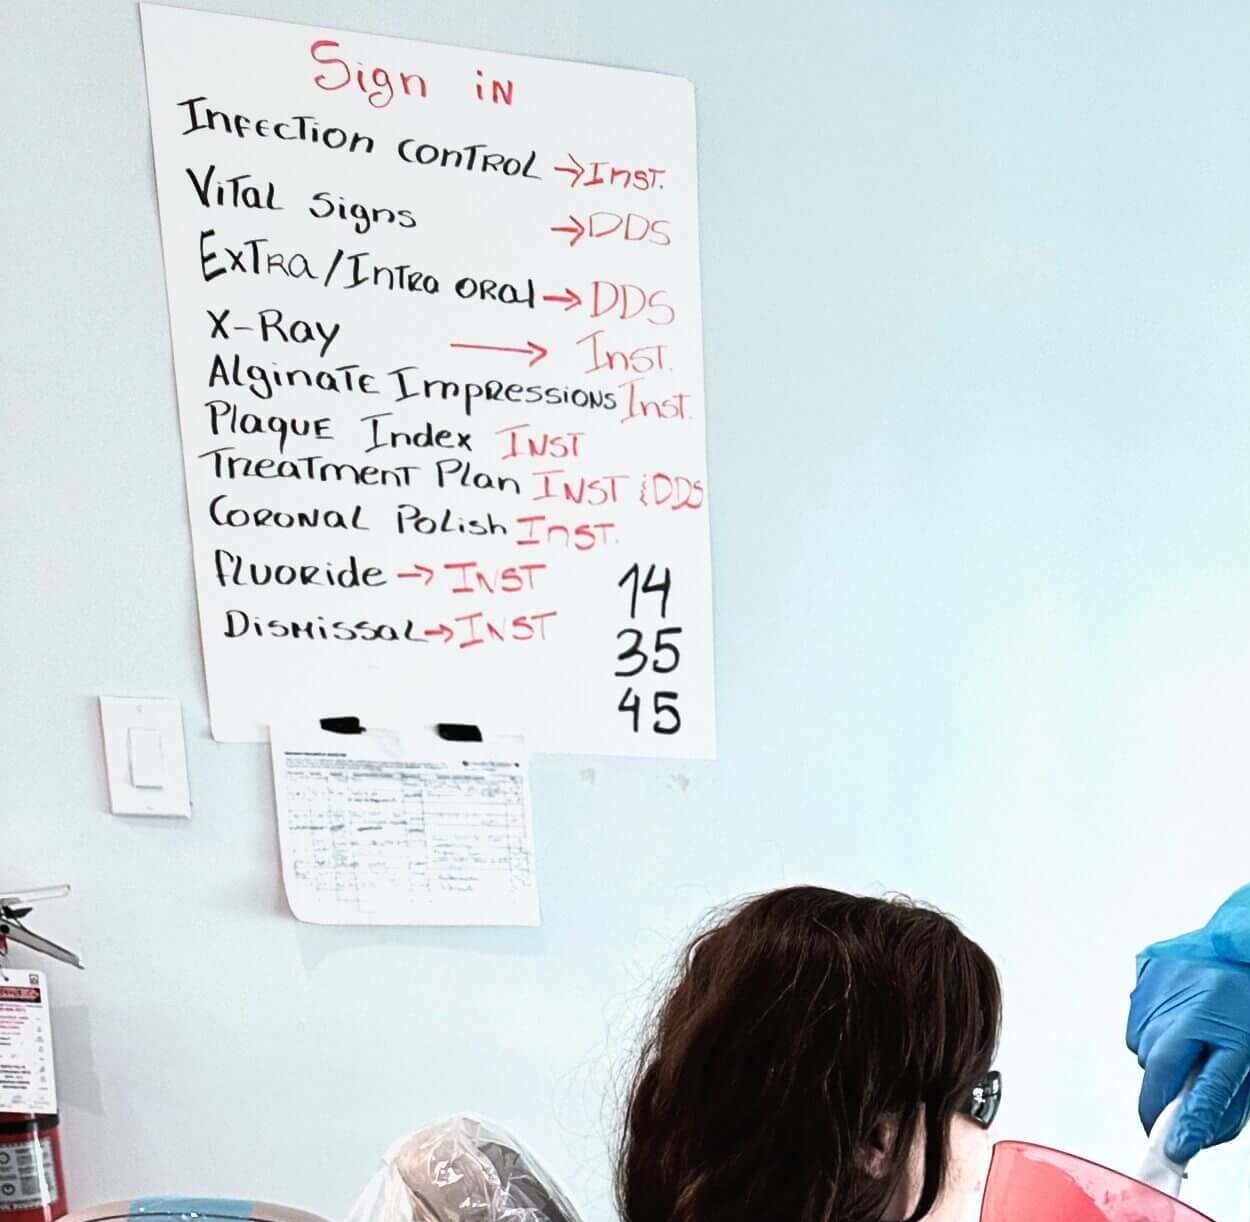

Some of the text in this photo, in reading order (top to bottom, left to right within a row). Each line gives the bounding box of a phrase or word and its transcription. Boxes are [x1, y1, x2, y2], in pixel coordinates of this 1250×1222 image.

[309, 39, 429, 109] Sign
[587, 211, 672, 247] DDS
[591, 280, 676, 326] DDS
[207, 309, 340, 357] X-Ray
[360, 411, 472, 453] Index
[435, 459, 521, 495] Plan
[618, 562, 673, 619] 14
[614, 627, 683, 677] 35
[617, 686, 682, 736] 45
